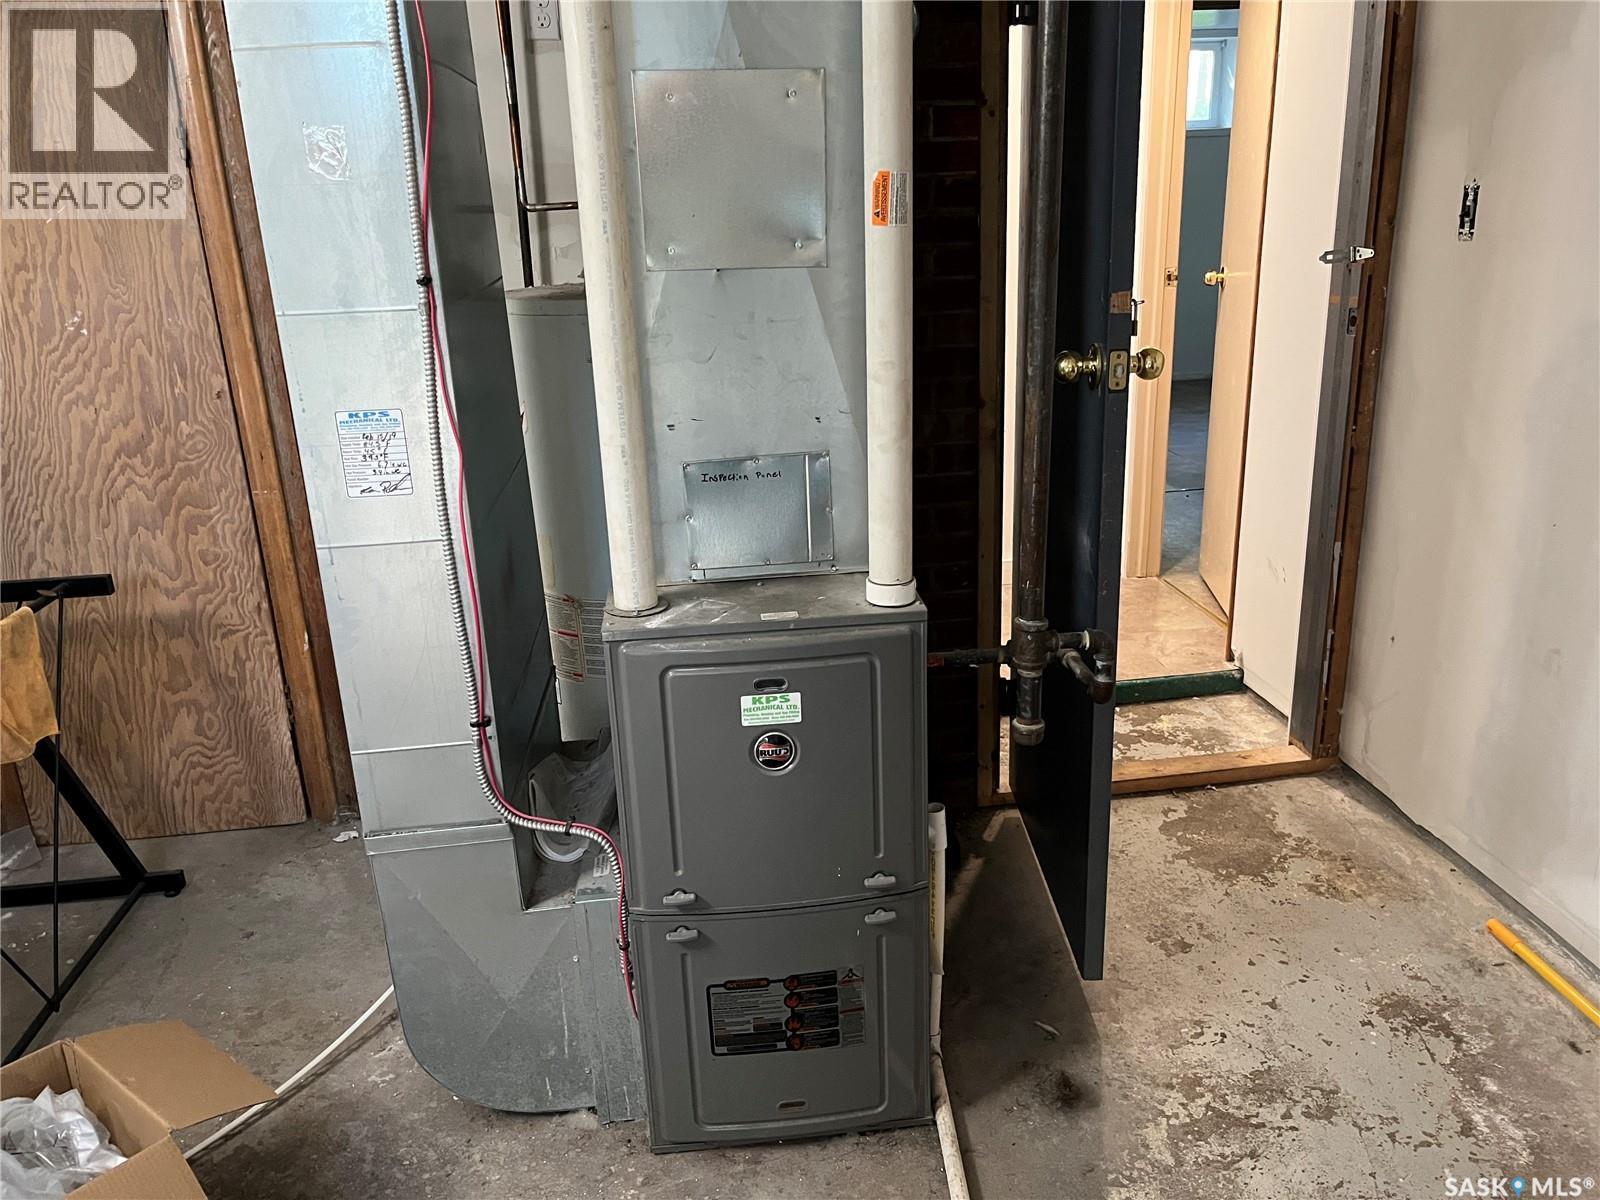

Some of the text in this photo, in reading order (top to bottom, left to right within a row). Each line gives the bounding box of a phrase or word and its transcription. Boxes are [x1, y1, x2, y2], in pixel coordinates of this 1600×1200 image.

[600, 171, 608, 212] SYSTEM
[348, 410, 390, 419] KPS
[618, 401, 626, 438] SYSTEM
[339, 418, 383, 426] MECHANICAL
[701, 470, 782, 482] Inspection Panel
[752, 694, 790, 706] KPS
[743, 704, 784, 713] MECHANICAL
